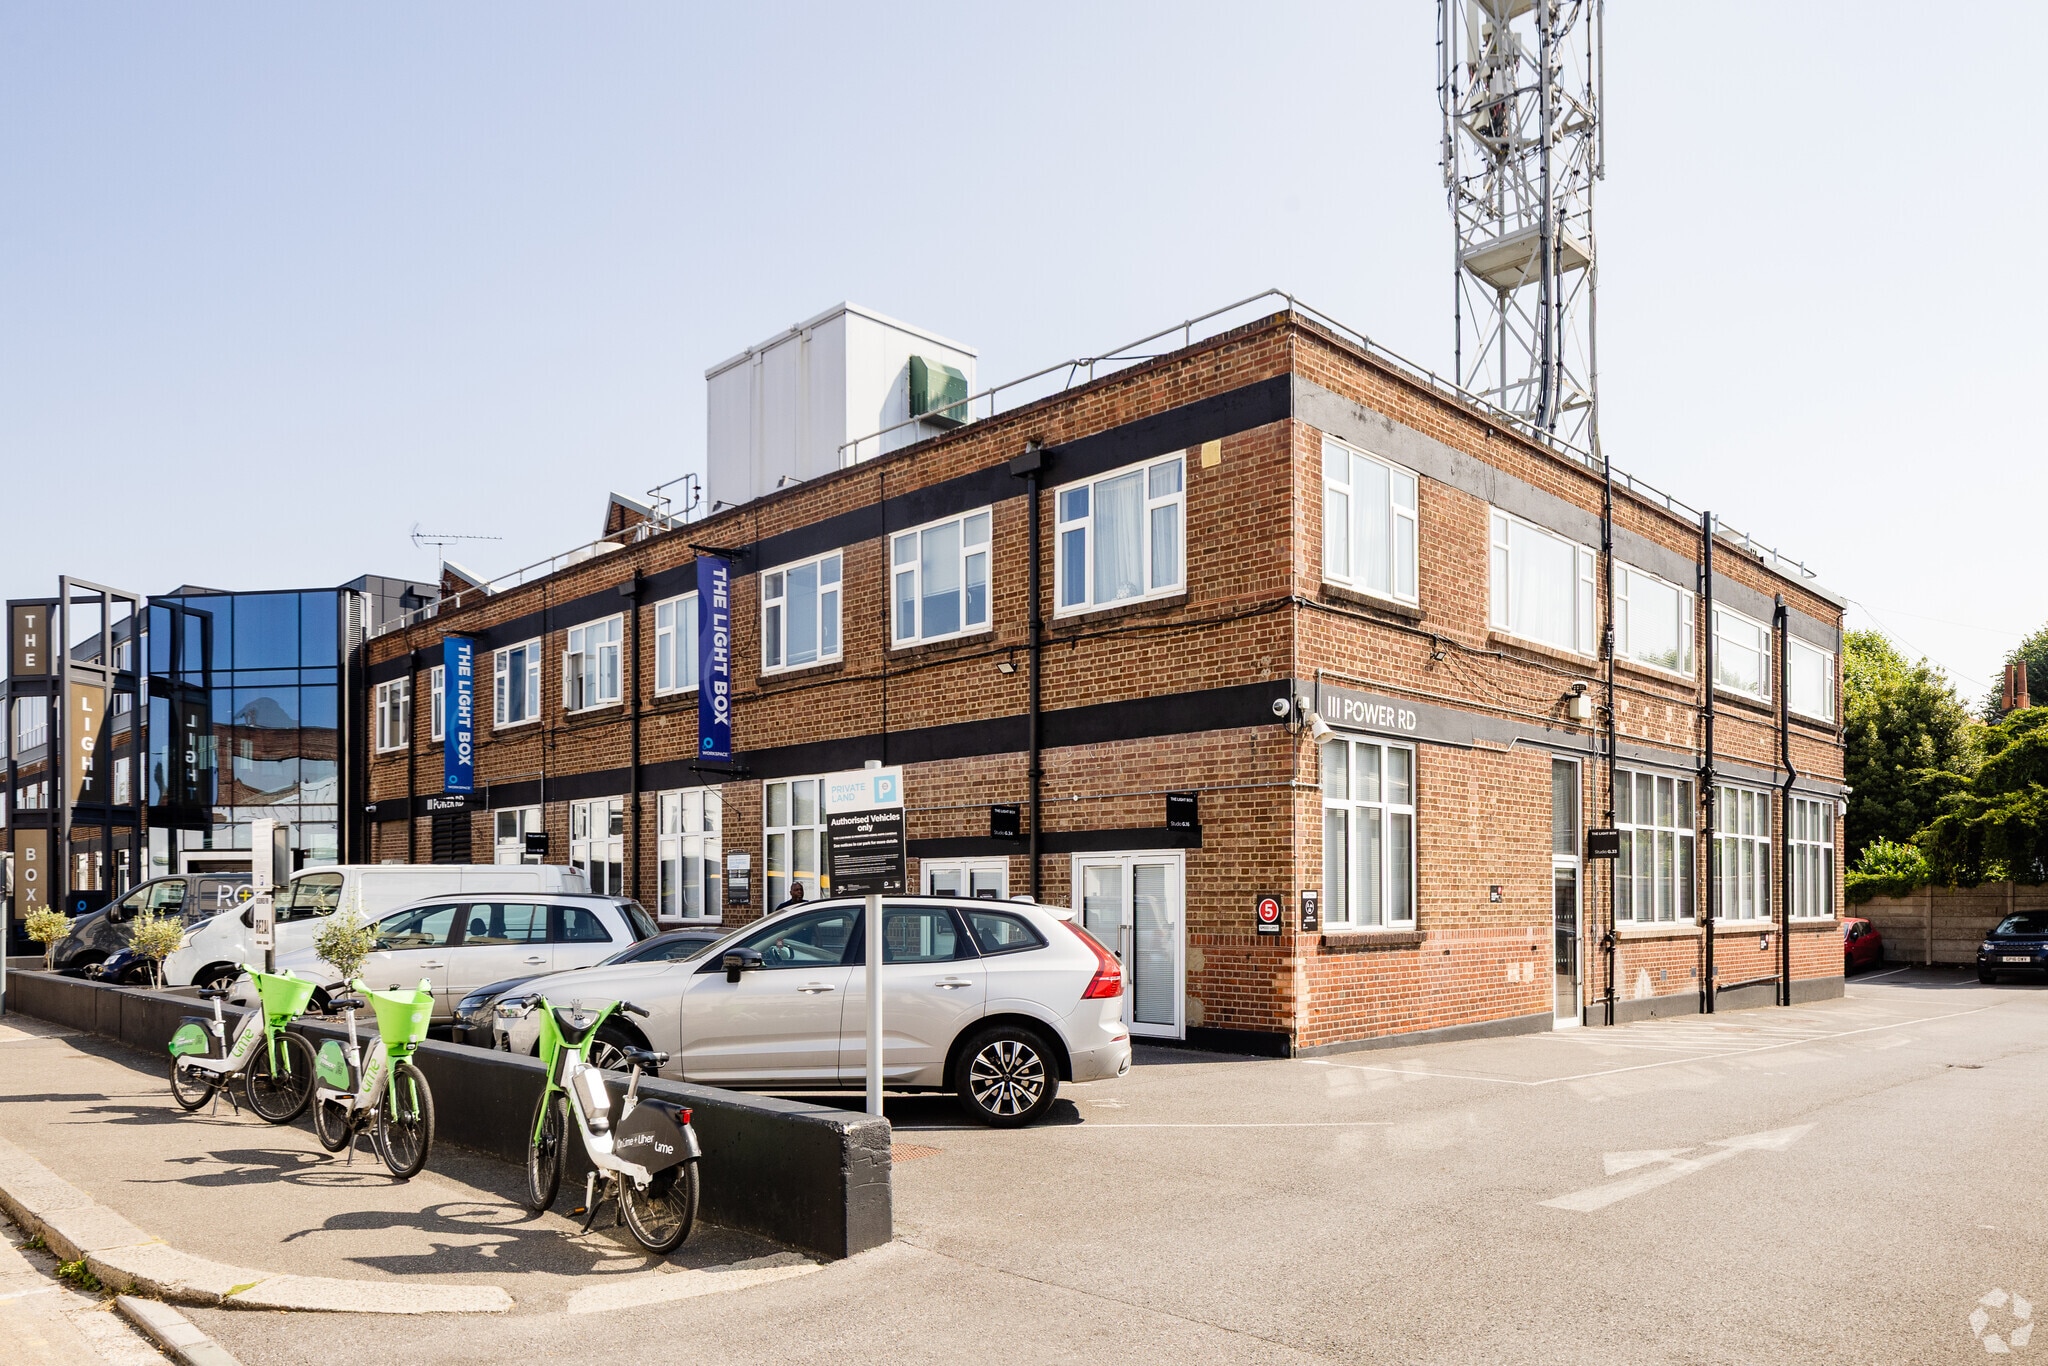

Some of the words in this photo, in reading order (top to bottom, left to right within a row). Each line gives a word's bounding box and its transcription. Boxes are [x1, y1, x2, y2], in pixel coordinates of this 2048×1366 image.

[713, 568, 727, 609] THE
[25, 615, 36, 667] THE
[713, 614, 728, 676] LIGHT
[458, 645, 471, 676] THE
[458, 680, 471, 728] LIGHT
[714, 682, 728, 726] BOX
[1344, 699, 1395, 728] POWER
[1398, 709, 1417, 731] RD
[81, 697, 95, 791] LIGHT
[458, 732, 472, 765] BOX
[831, 782, 866, 794] PRIVATE
[832, 793, 855, 803] LAND
[831, 815, 869, 827] Authorised
[870, 812, 901, 823] Vehicles
[857, 824, 873, 833] only
[25, 848, 37, 901] BOX
[1264, 903, 1273, 918] 5
[231, 1028, 254, 1058] Lime
[362, 1058, 380, 1093] Lime
[654, 1141, 674, 1155] Lime
